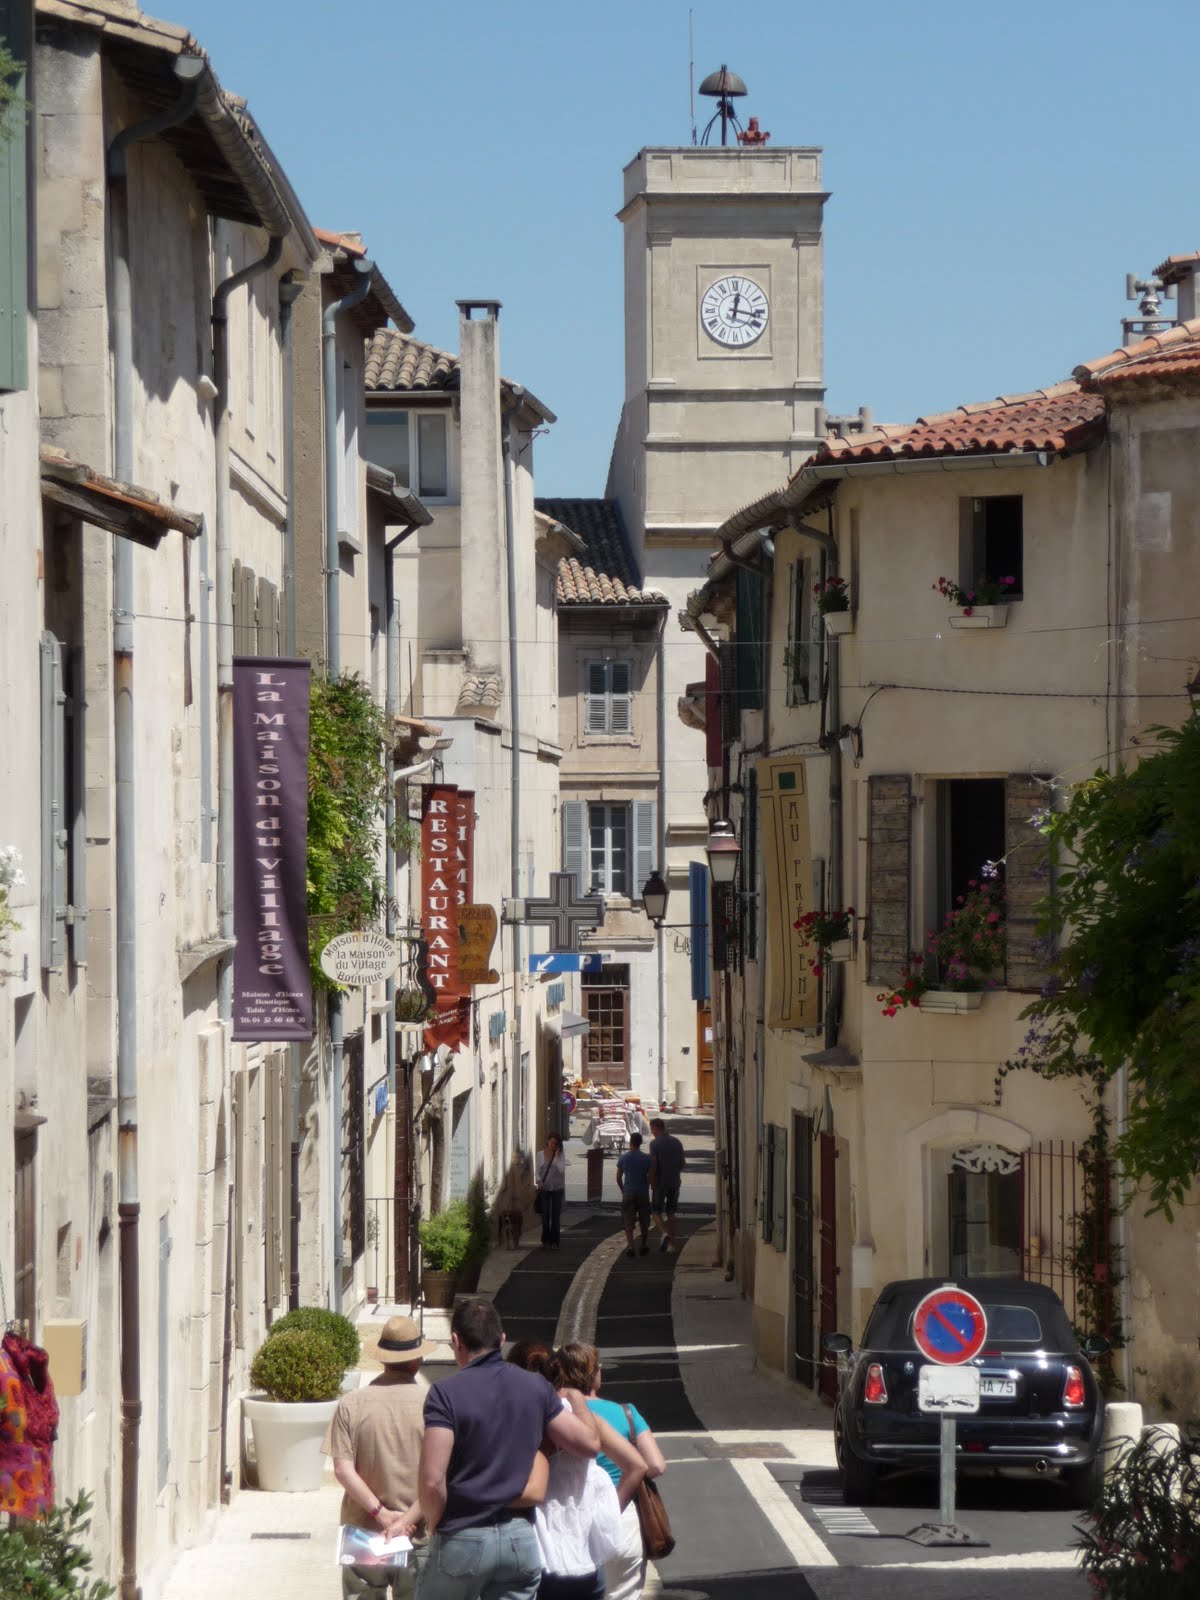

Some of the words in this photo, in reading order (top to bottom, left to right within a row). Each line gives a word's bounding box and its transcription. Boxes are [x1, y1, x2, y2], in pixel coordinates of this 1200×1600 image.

[255, 672, 287, 702] La
[253, 712, 287, 806] Maison
[255, 816, 283, 847] du
[789, 801, 800, 842] AU
[428, 800, 450, 988] RESTAURANT
[323, 934, 359, 958] Maison
[349, 949, 385, 959] Maison
[335, 960, 349, 970] du
[351, 960, 387, 971] Village
[337, 971, 384, 985] Boutique
[997, 1380, 1014, 1394] 75
